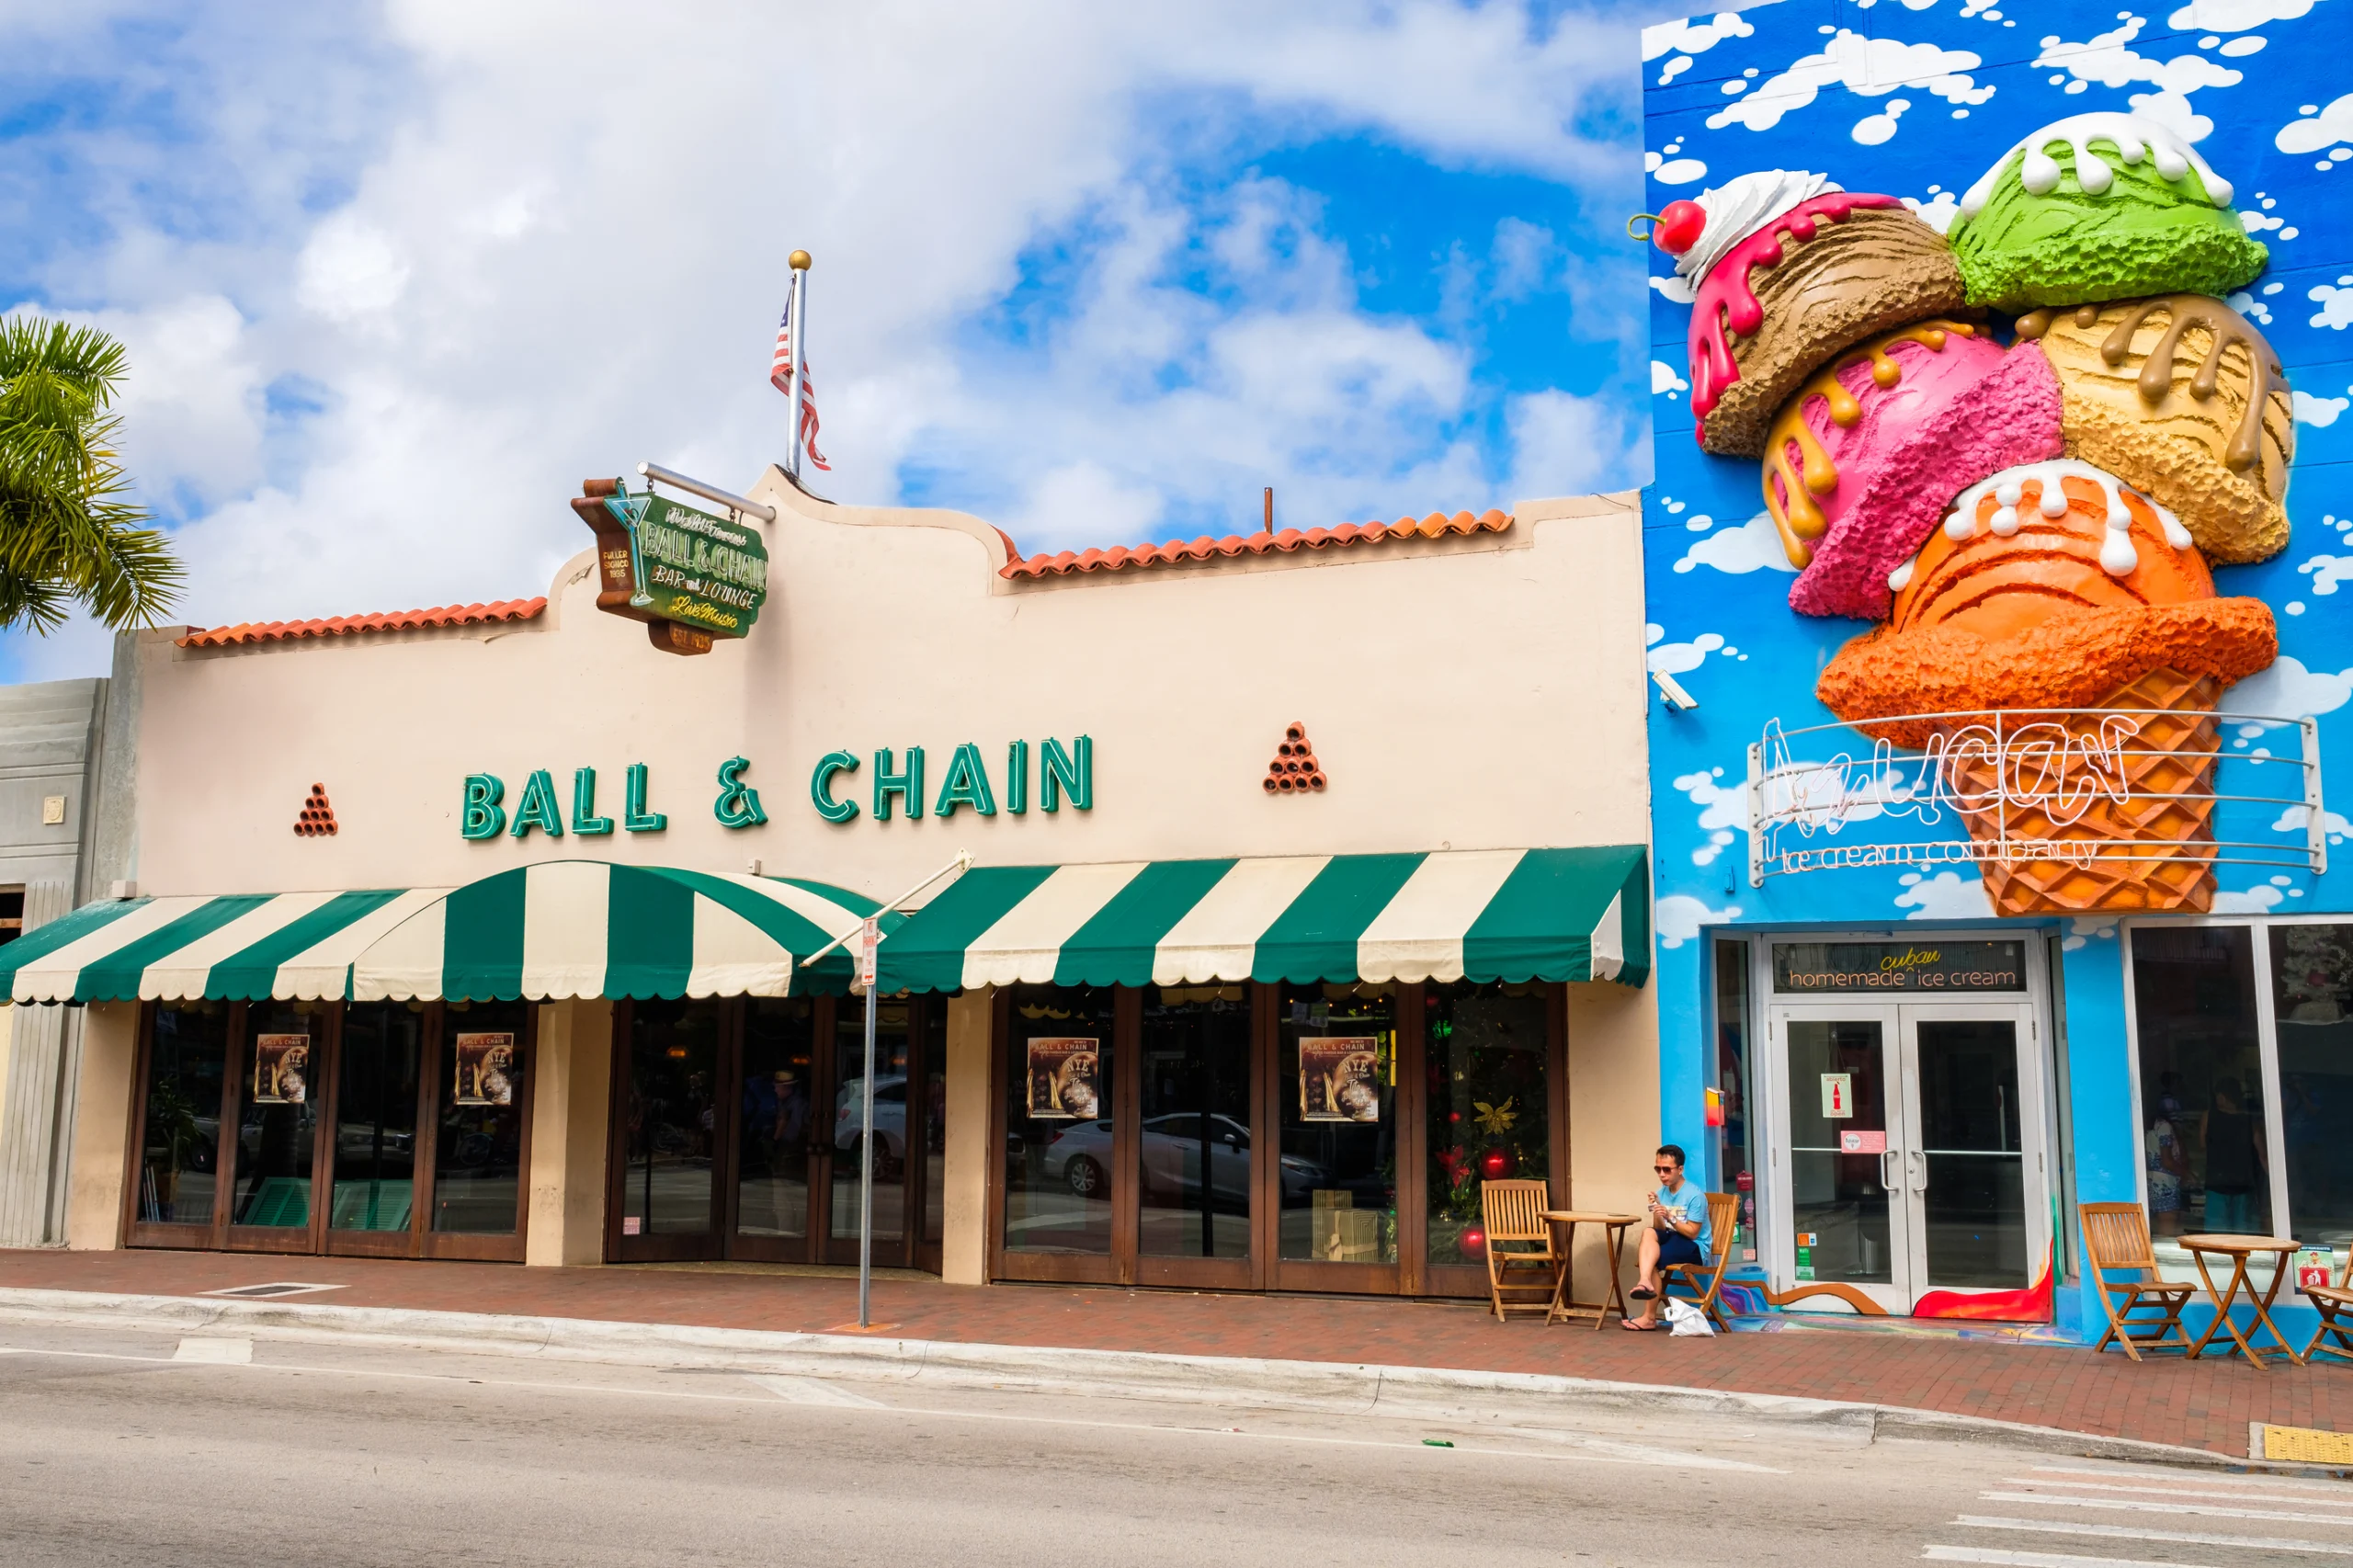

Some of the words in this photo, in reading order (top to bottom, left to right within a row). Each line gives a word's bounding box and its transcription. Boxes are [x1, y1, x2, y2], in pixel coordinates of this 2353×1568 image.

[641, 521, 695, 569] BALL
[695, 539, 712, 574] &
[712, 544, 769, 593] CHAIN
[652, 564, 686, 589] BAR
[699, 579, 758, 610] LOUNGE
[672, 595, 700, 616] Live
[697, 602, 739, 629] Music
[460, 762, 668, 841] BALL
[713, 756, 769, 827] &
[811, 733, 1094, 824] CHAIN
[1820, 843, 1914, 869] cream
[1926, 838, 2099, 870] company
[1880, 948, 1941, 971] cuban
[1789, 969, 1905, 987] homemade
[1917, 969, 1945, 987] ice
[1950, 971, 2016, 986] cream
[487, 1051, 506, 1064] NYE
[1067, 1060, 1090, 1072] NYE
[1344, 1060, 1369, 1073] NYE
